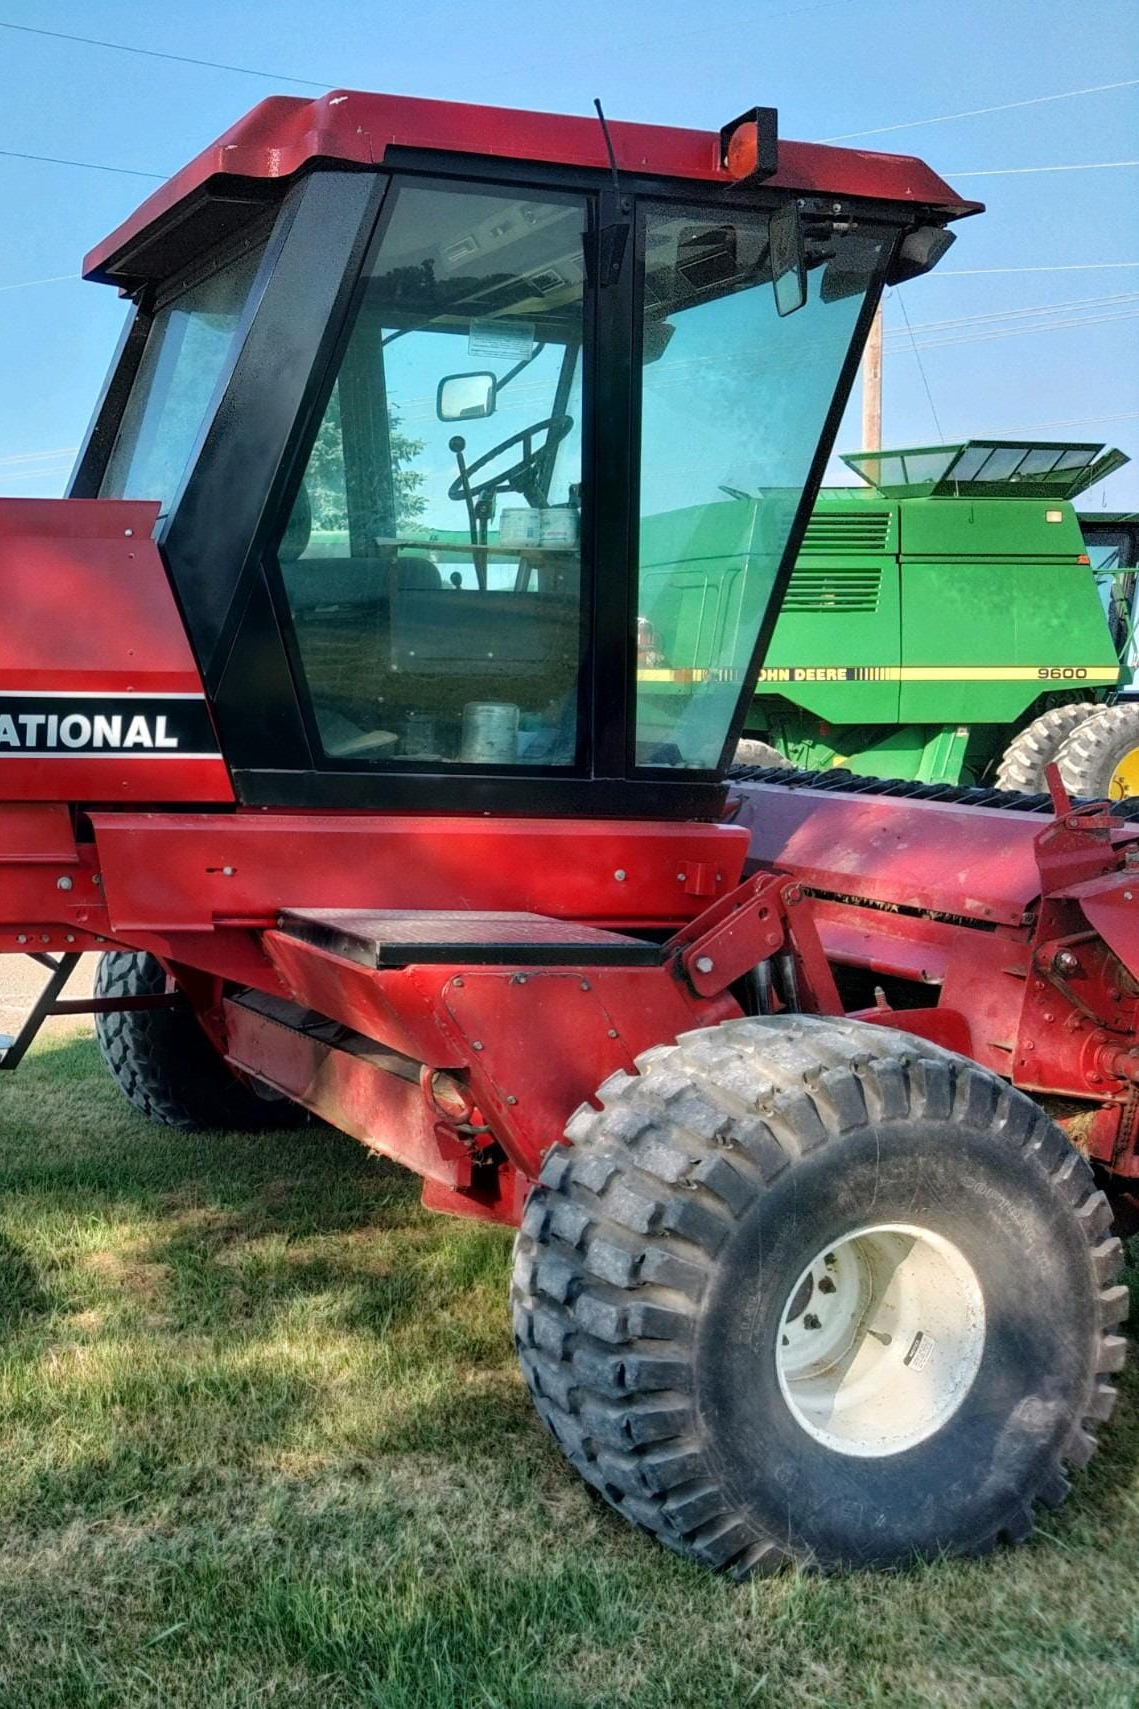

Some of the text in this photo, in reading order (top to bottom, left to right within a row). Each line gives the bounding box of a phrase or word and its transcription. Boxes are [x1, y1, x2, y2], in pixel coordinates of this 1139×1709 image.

[757, 668, 847, 681] OHN DEERE
[1038, 668, 1087, 679] 9600
